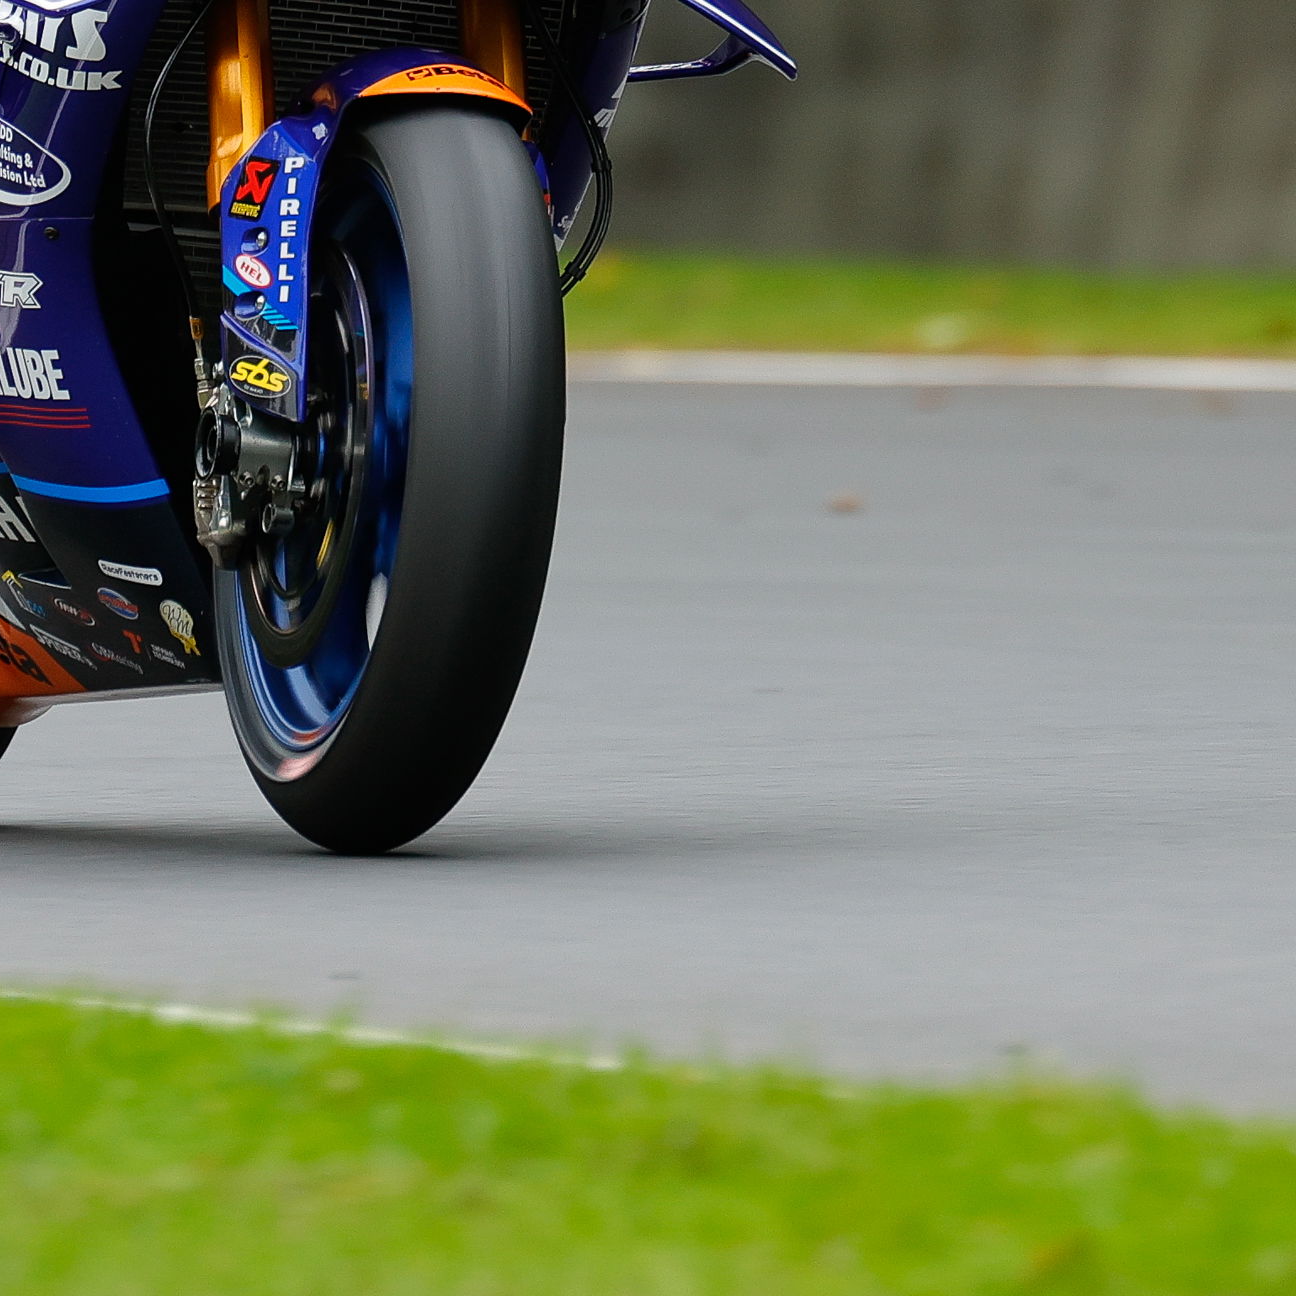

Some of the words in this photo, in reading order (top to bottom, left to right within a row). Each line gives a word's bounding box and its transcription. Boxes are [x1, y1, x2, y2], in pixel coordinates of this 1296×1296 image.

[24, 153, 34, 168] &
[23, 171, 46, 189] Ltd
[278, 156, 305, 303] PIRELLI
[239, 261, 264, 283] HEL
[230, 357, 288, 393] sbs
